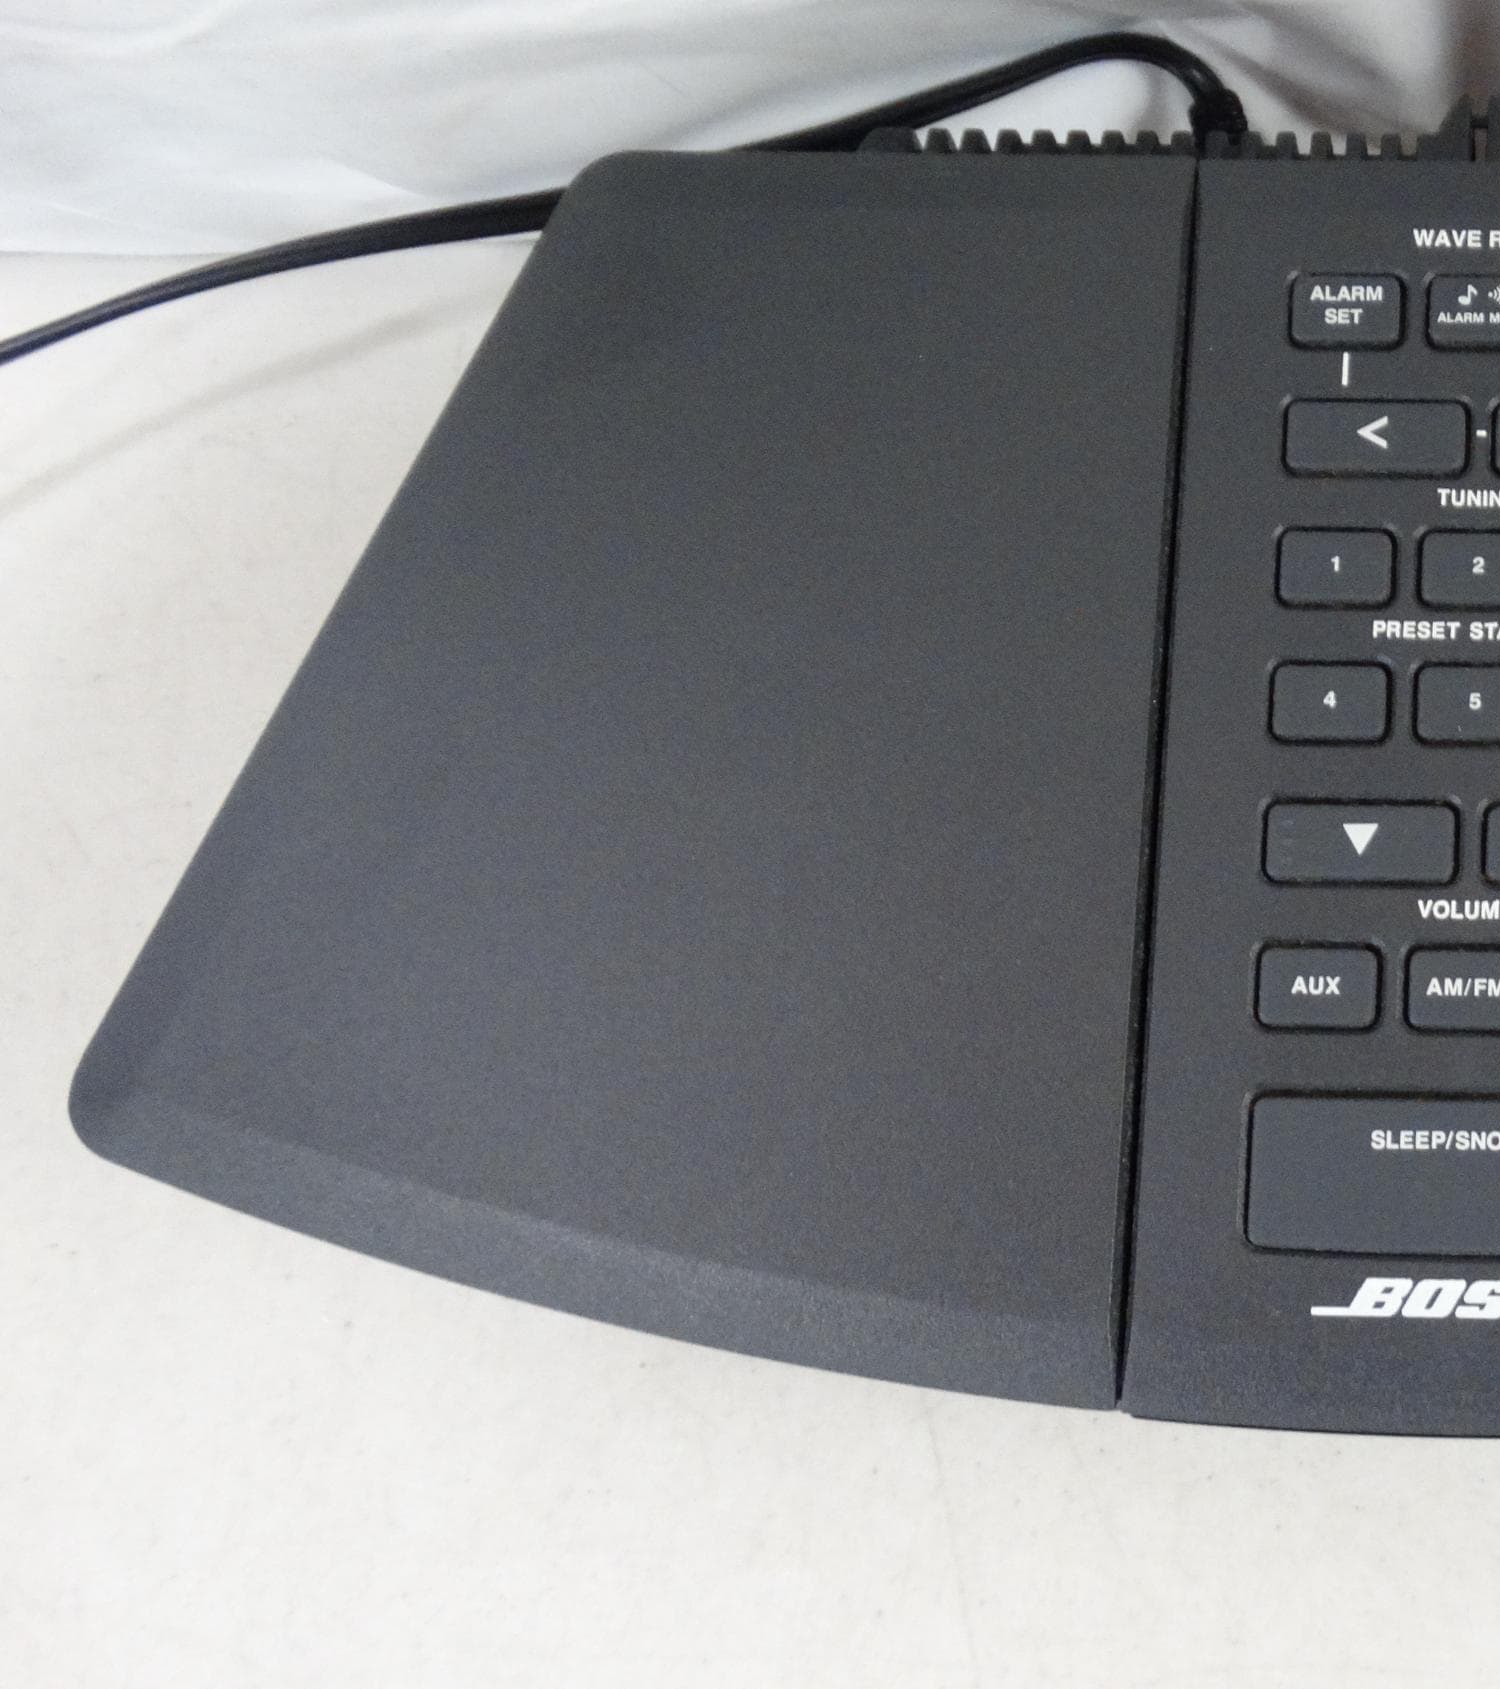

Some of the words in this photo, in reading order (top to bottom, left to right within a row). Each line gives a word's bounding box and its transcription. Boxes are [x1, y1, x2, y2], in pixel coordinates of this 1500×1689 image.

[1414, 229, 1481, 248] WAVE
[1310, 285, 1383, 302] ALARM
[1325, 308, 1362, 324] SET
[1437, 312, 1485, 323] ALARM
[1331, 556, 1340, 572] 1
[1473, 557, 1485, 573] 2
[1373, 621, 1460, 639] PRESET
[1324, 691, 1336, 707] 4
[1469, 693, 1481, 709] 5
[1292, 976, 1340, 995] AUX
